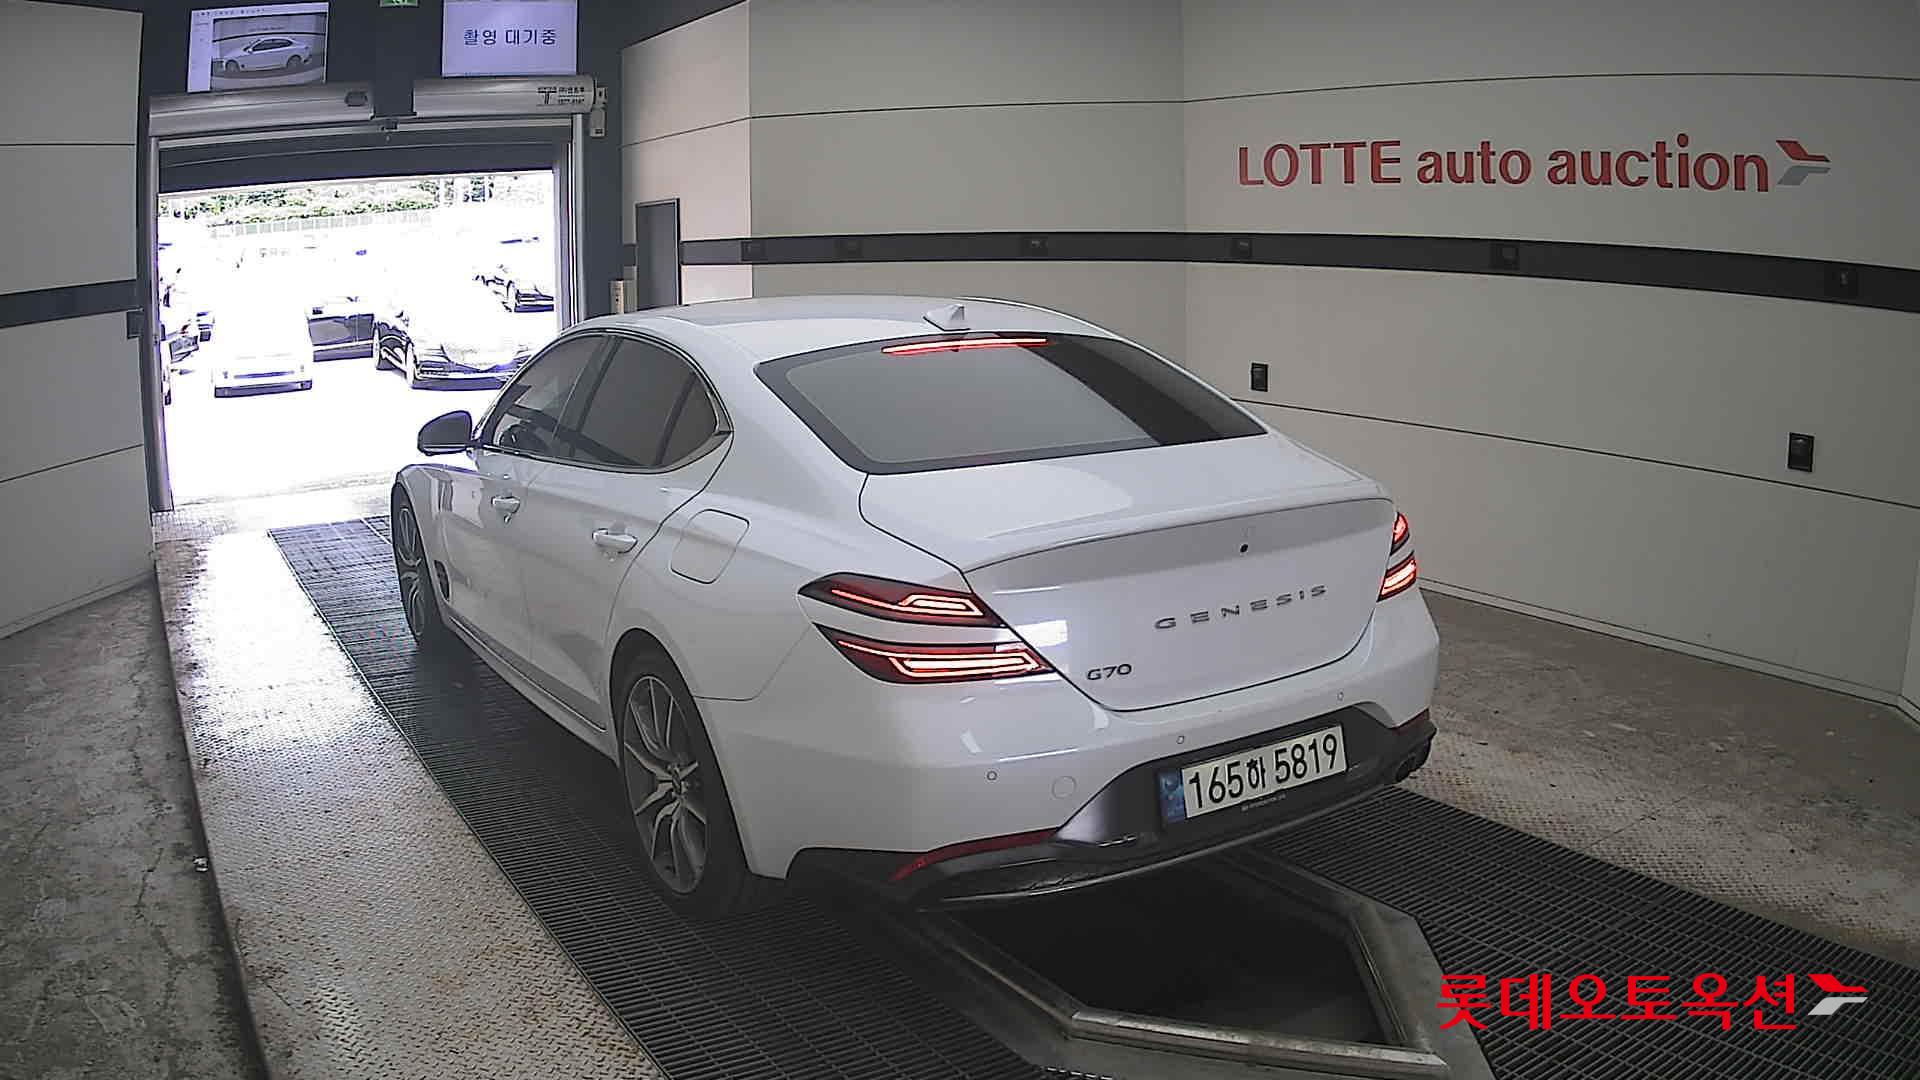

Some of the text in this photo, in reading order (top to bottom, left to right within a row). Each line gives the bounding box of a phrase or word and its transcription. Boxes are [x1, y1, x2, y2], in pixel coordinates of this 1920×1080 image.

[463, 28, 557, 46] 촬영 대기중
[1238, 132, 1769, 193] LOTTE auto auction
[1154, 584, 1326, 630] GENESIS
[1087, 663, 1132, 681] G70
[1274, 733, 1338, 784] 5819
